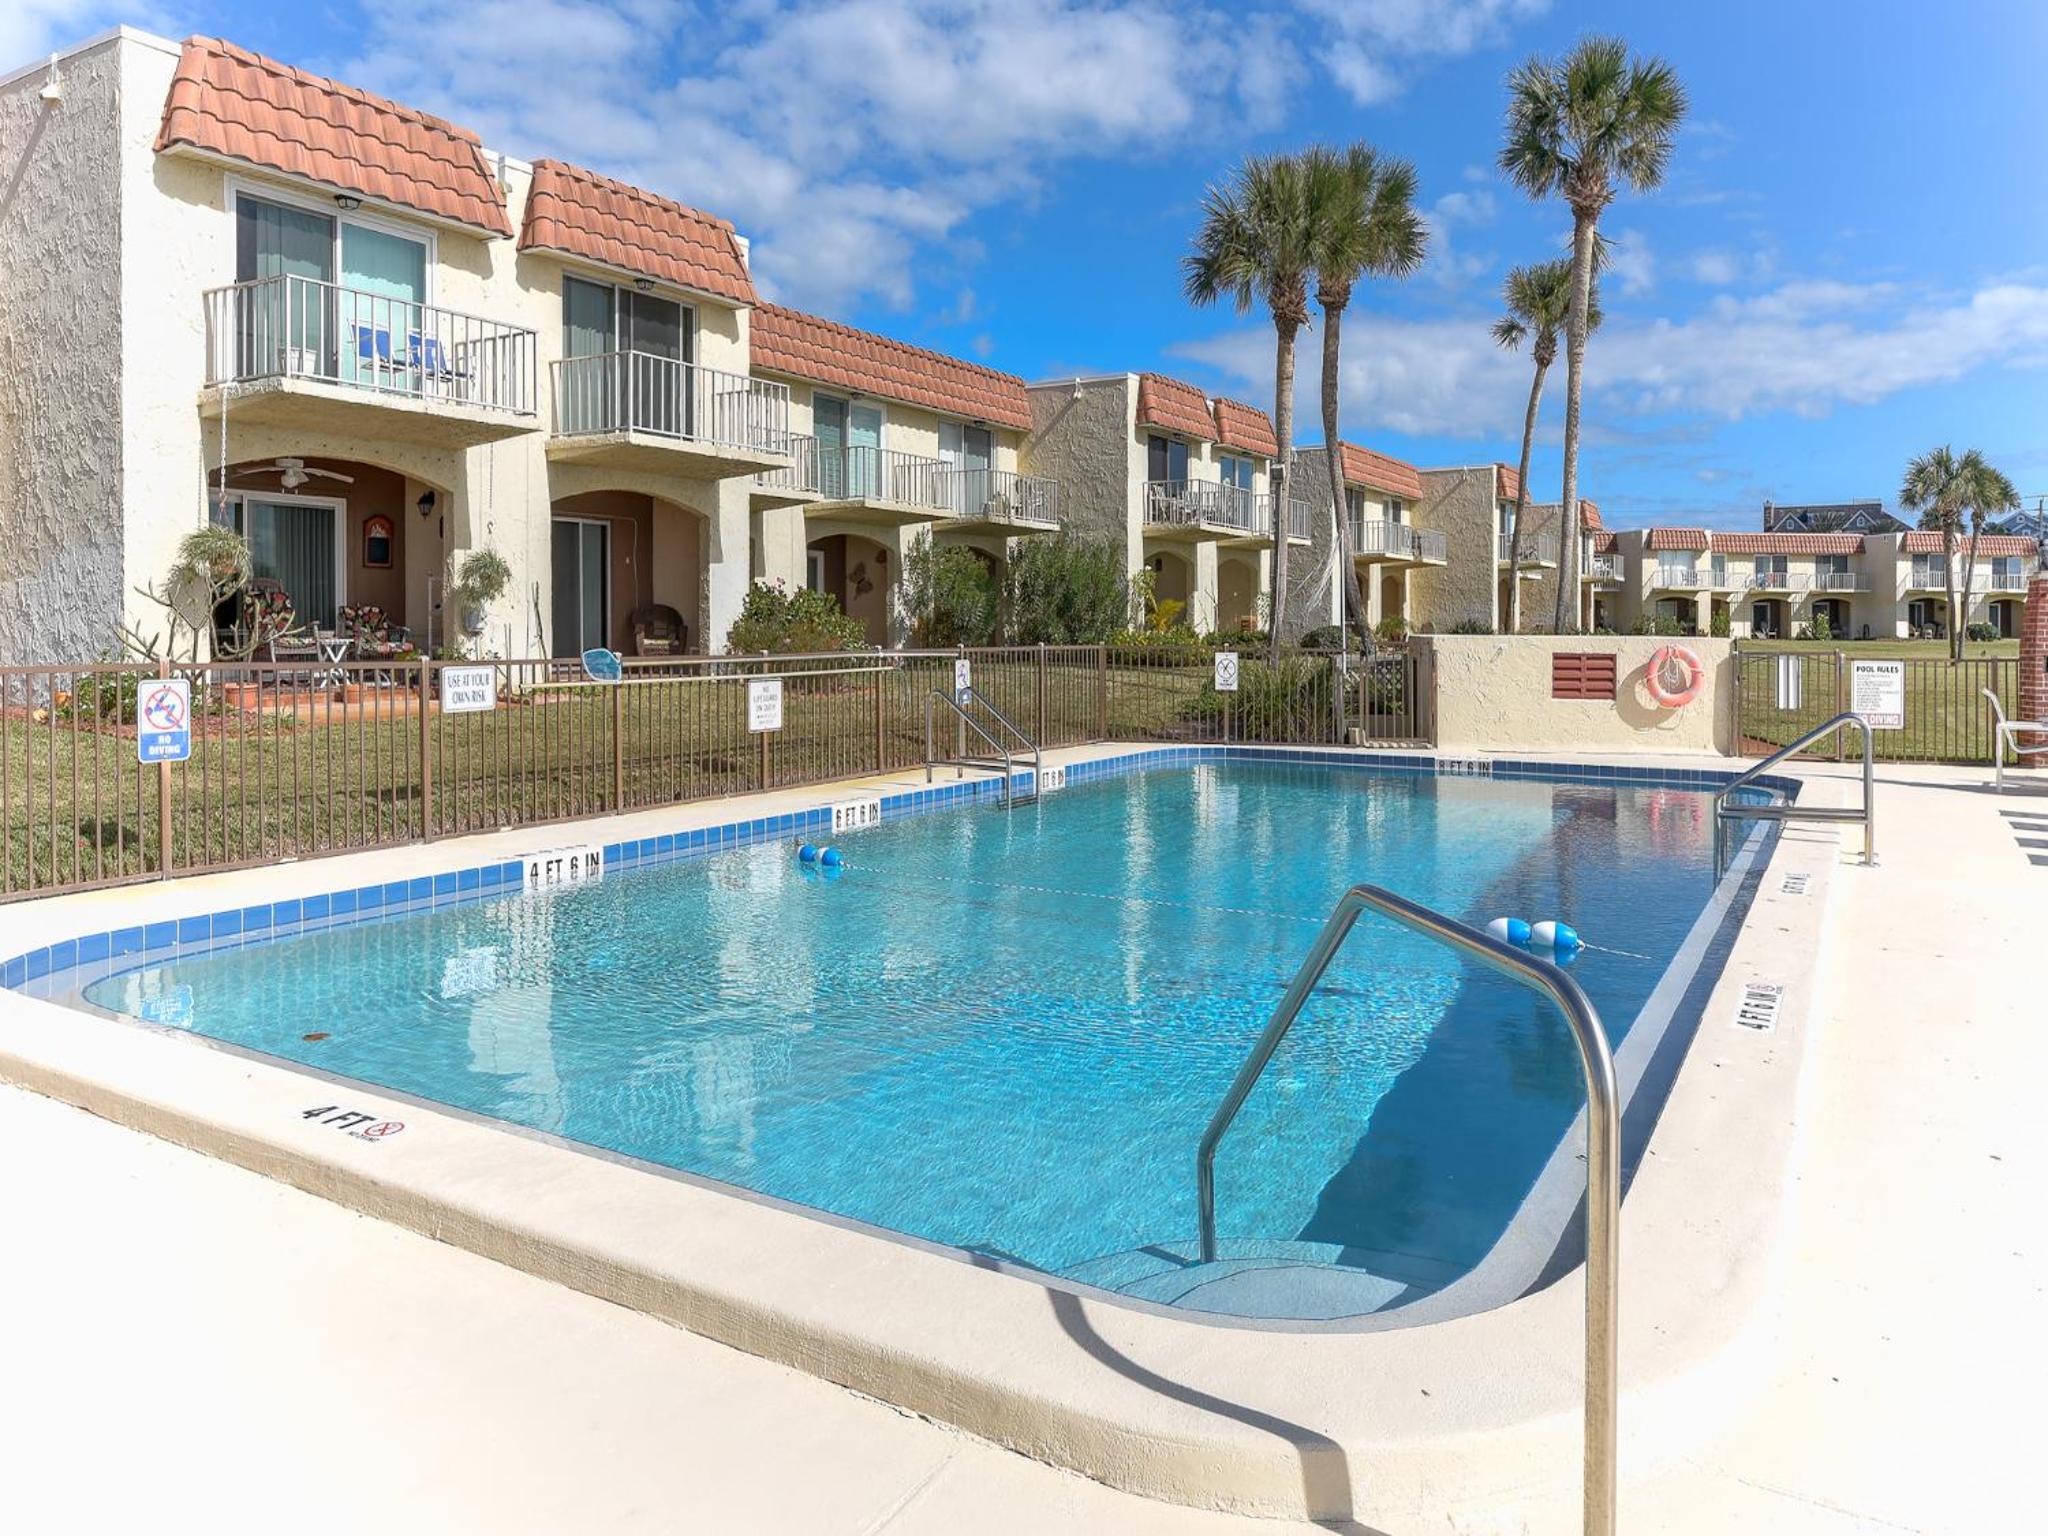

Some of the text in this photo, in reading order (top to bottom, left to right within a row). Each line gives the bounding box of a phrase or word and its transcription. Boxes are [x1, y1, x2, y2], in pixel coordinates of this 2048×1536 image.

[1856, 665, 1899, 674] POOL RULES
[447, 674, 461, 688] USE
[471, 672, 490, 687] YOUR
[452, 689, 486, 704] OWN RISK
[1869, 714, 1899, 725] DIVING
[158, 734, 172, 744] NO
[148, 744, 181, 756] DIVING
[1478, 761, 1490, 773] IN
[529, 851, 600, 878] 4 FT 6 IN
[1740, 1009, 1772, 1022] FT
[1737, 1021, 1769, 1030] 4
[302, 1105, 378, 1130] 4 FT
